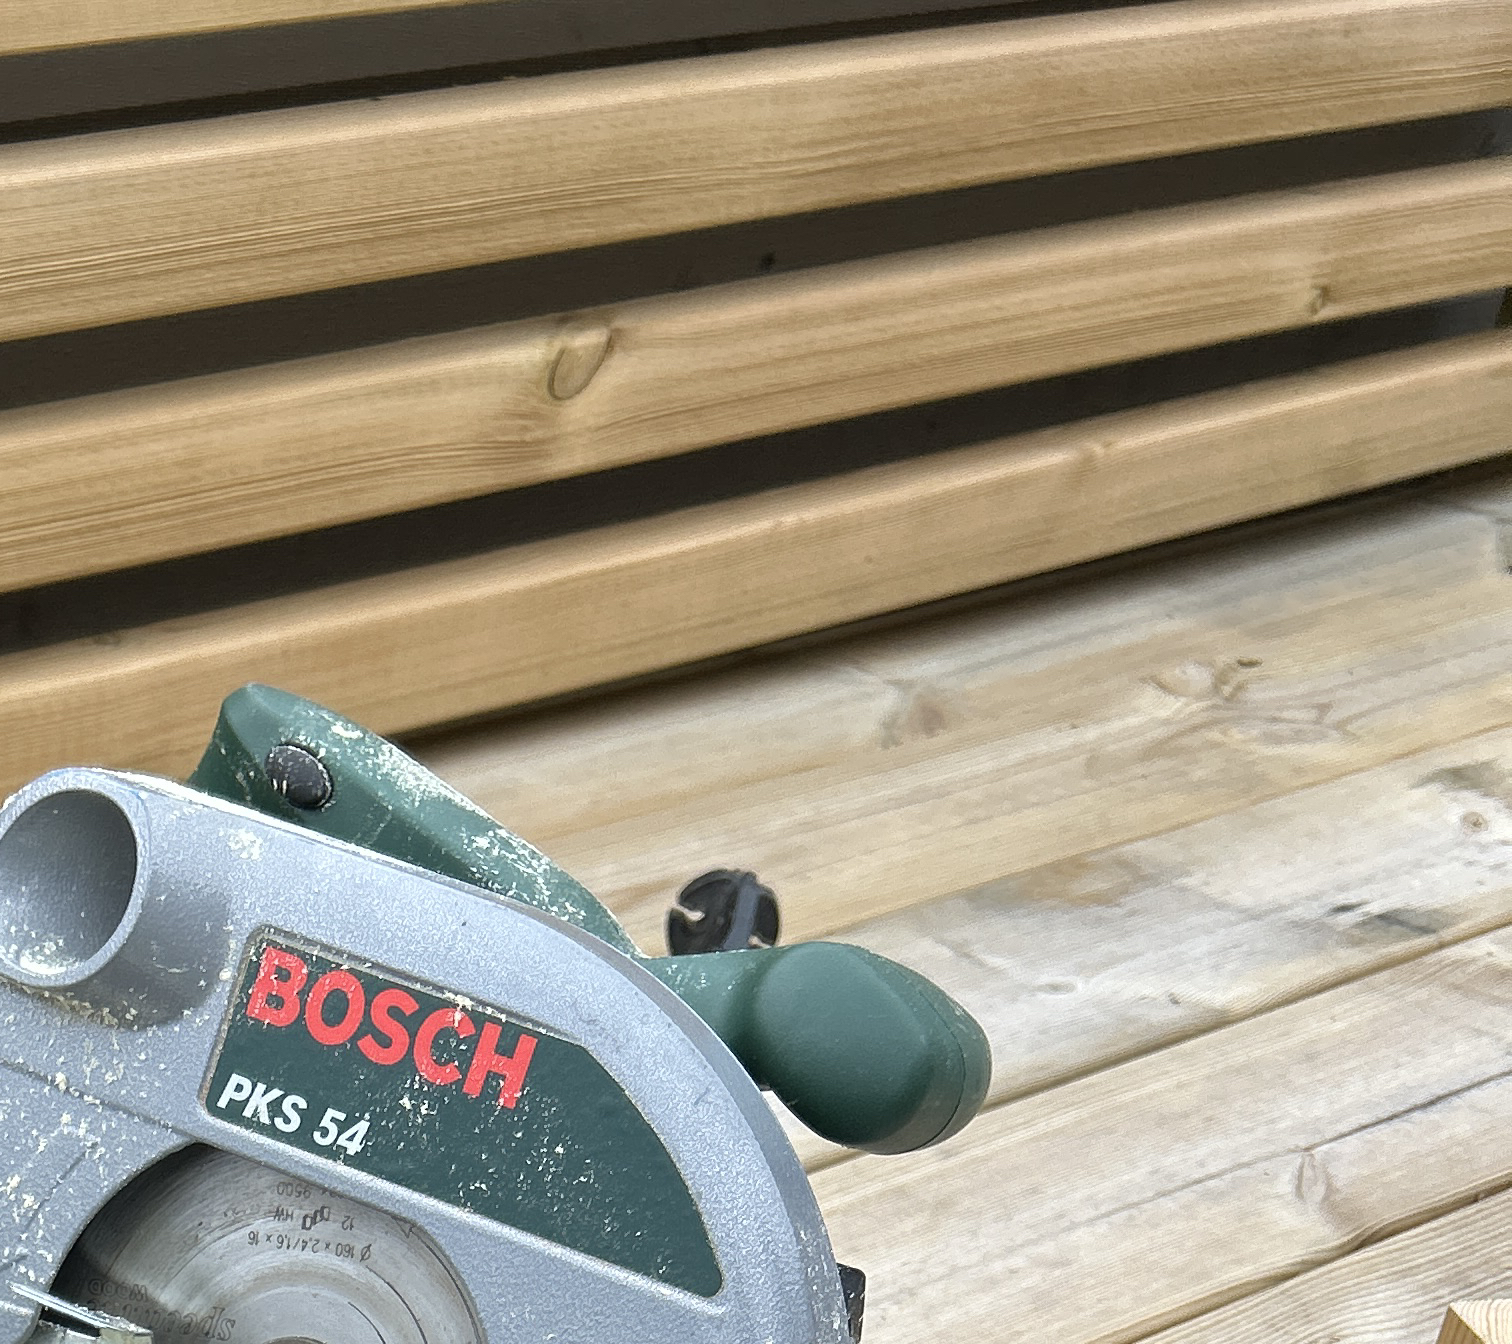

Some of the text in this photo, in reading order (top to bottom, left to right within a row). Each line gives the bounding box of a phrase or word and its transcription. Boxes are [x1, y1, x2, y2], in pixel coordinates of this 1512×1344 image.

[246, 946, 538, 1110] BOSCH
[216, 1073, 372, 1156] PKS 54
[89, 1278, 148, 1301] WOOD
